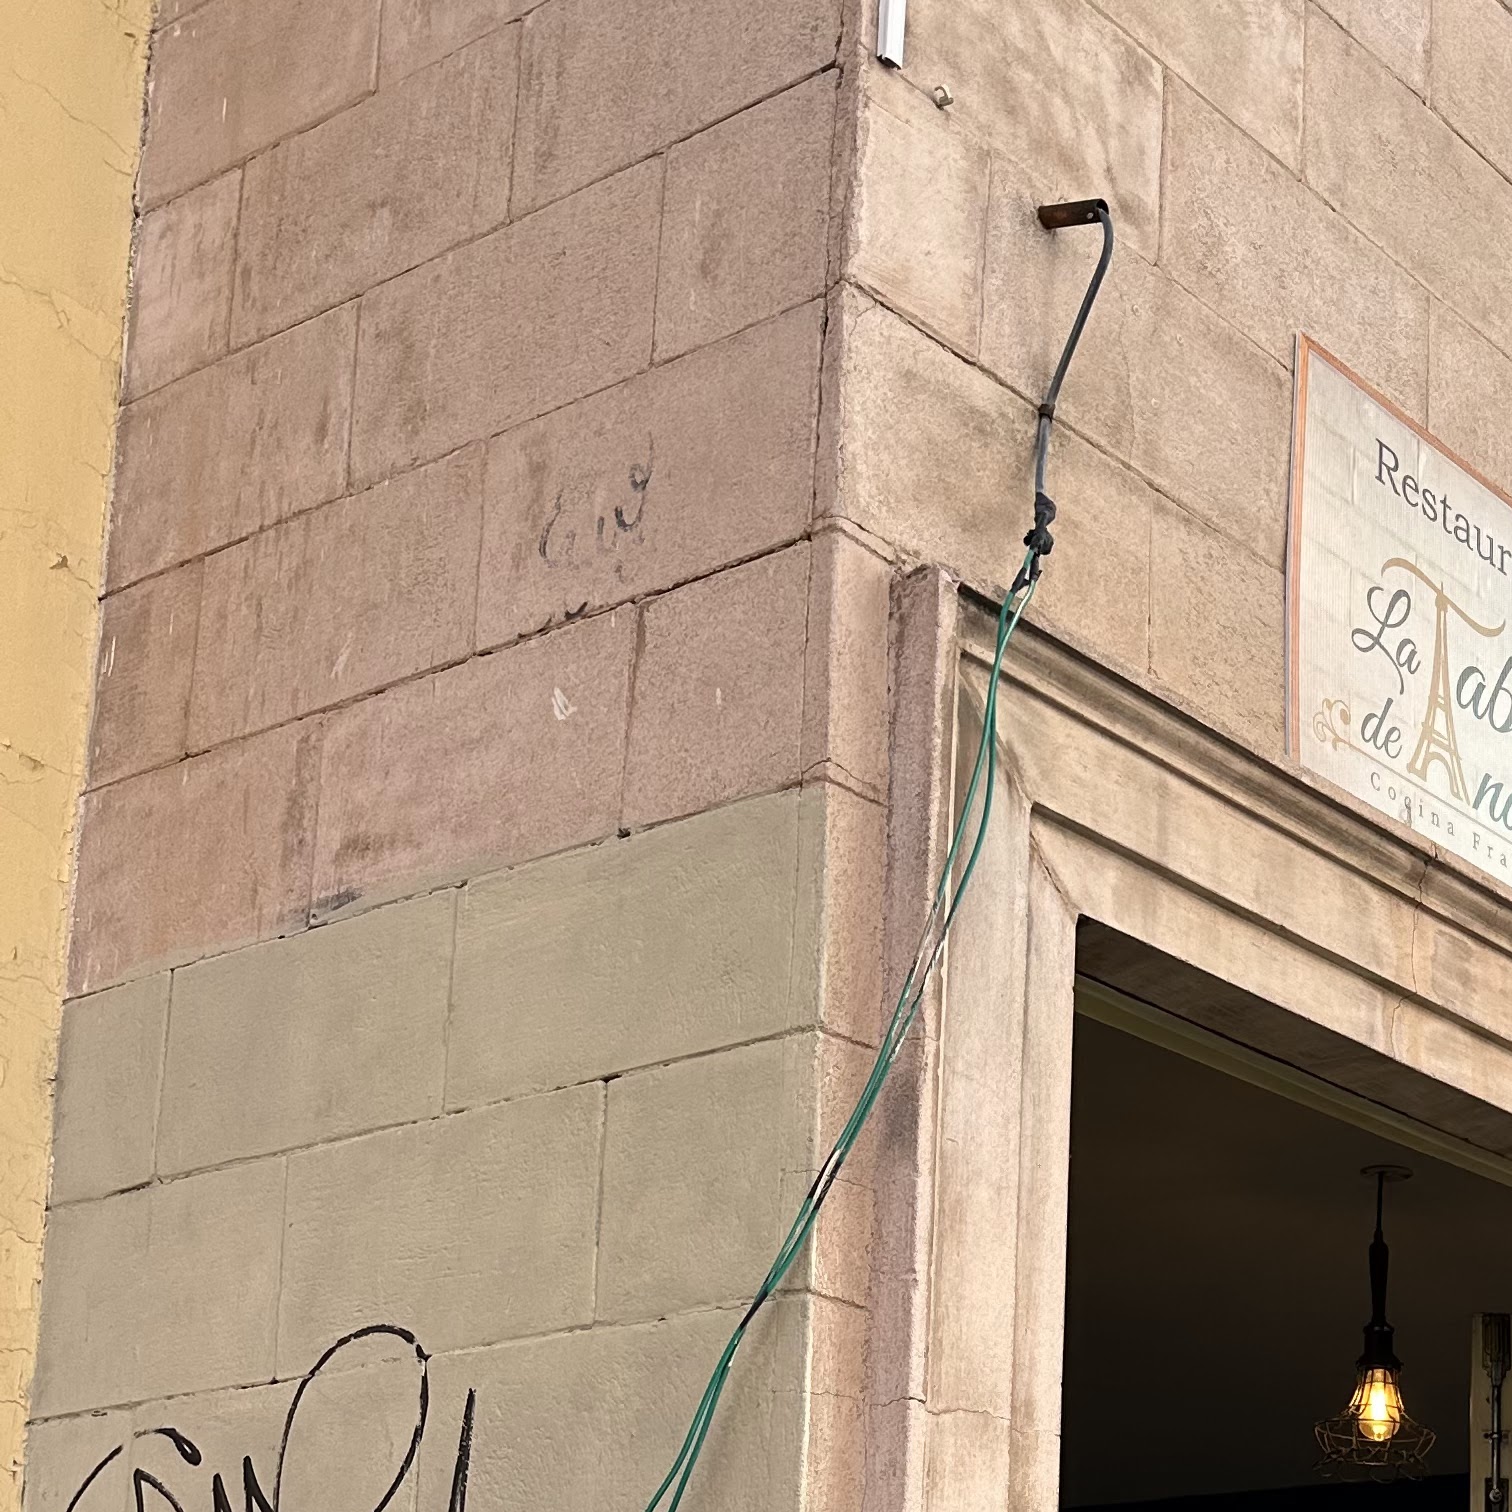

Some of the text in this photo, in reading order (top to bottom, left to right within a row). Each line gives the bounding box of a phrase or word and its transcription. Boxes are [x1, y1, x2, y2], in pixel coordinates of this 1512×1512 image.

[1351, 585, 1421, 695] La
[1360, 697, 1403, 760] de
[1370, 771, 1456, 837] Cocina
